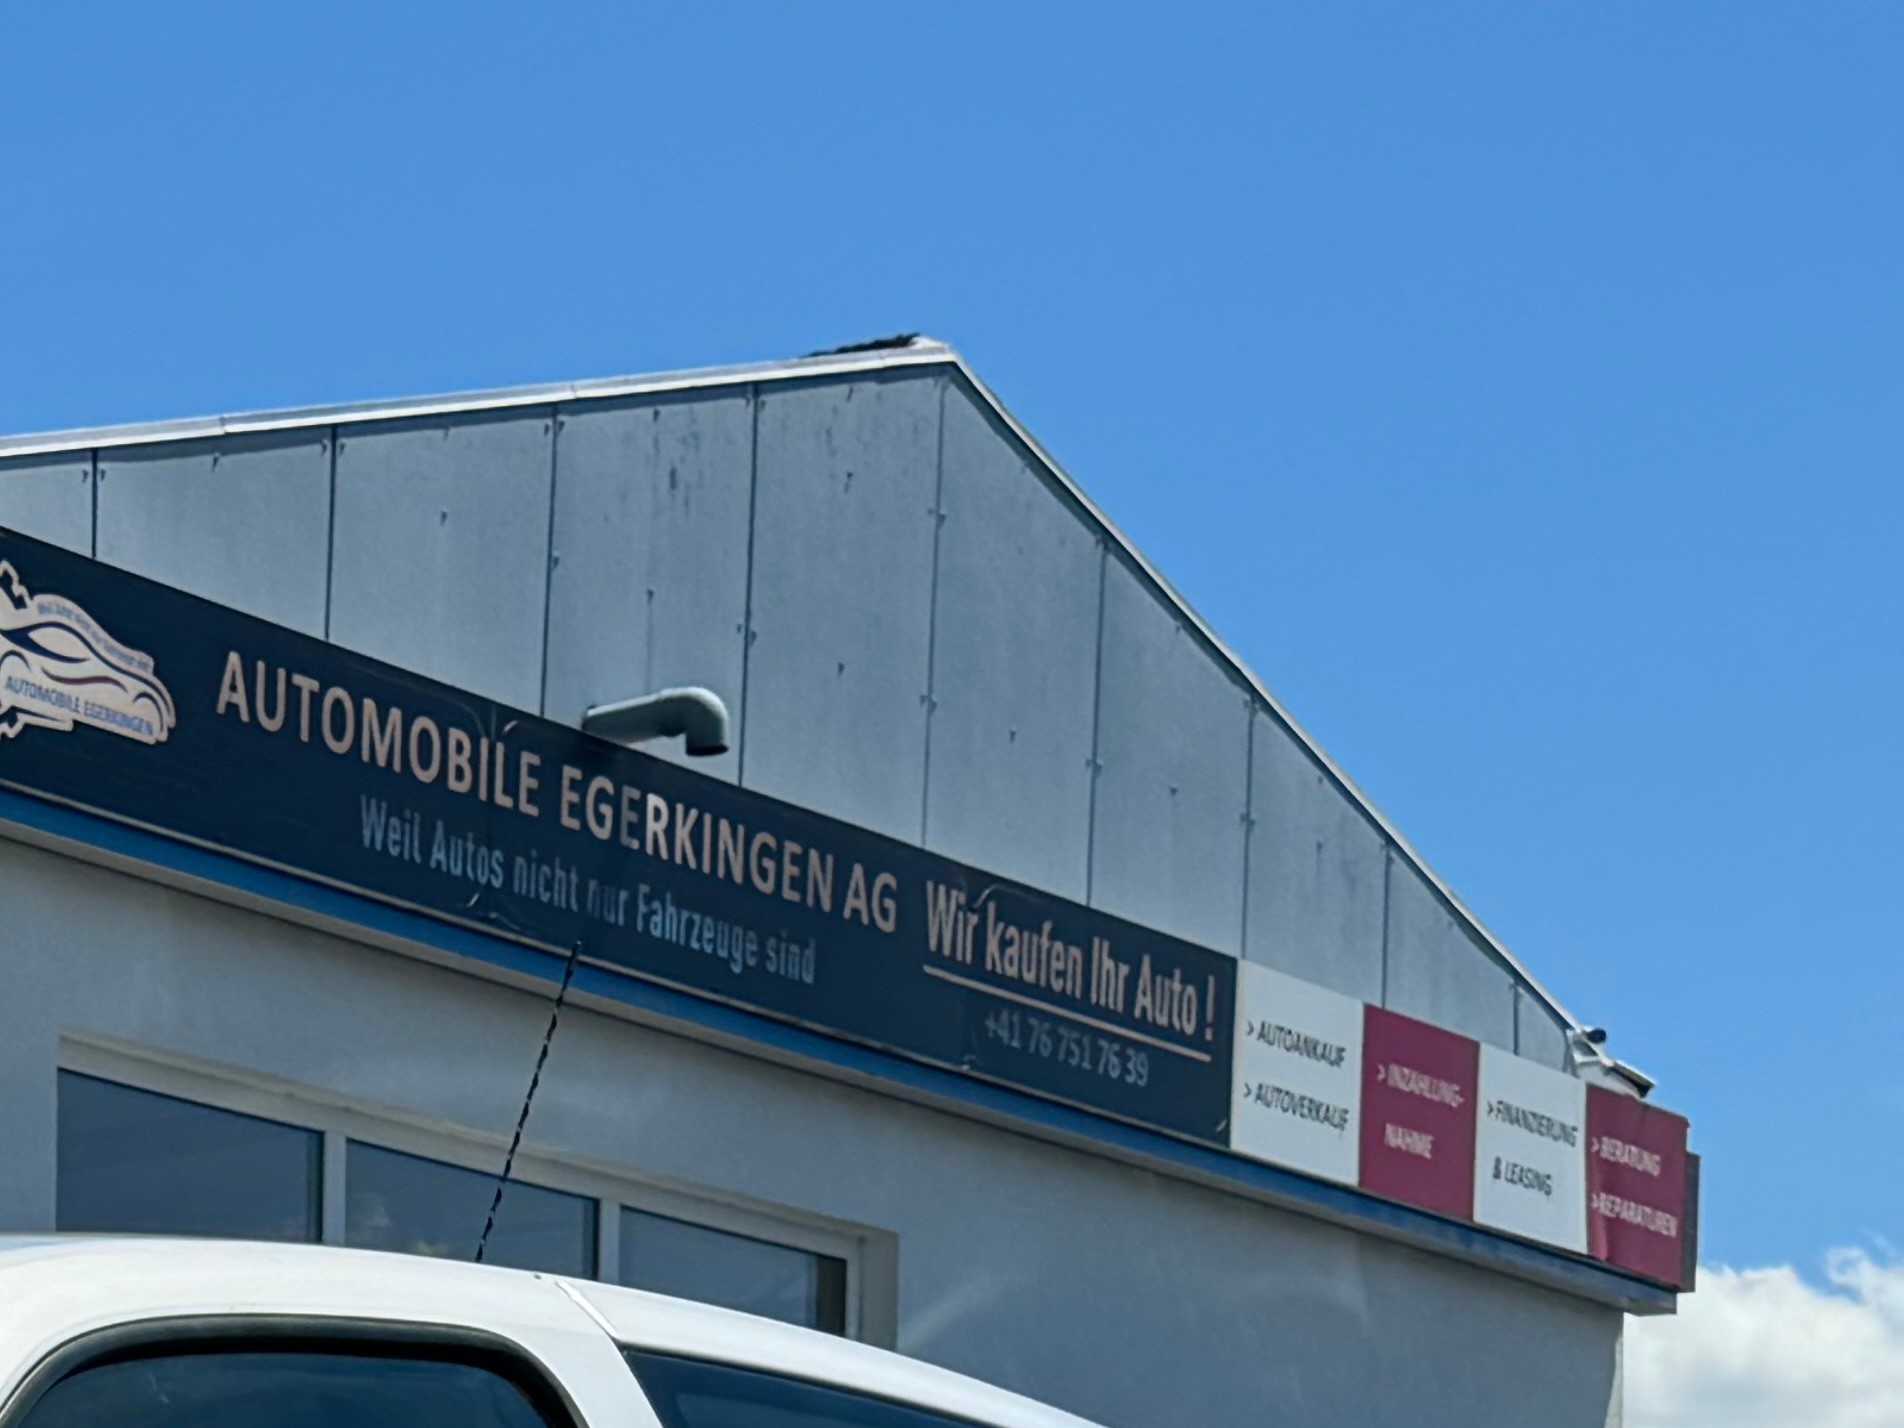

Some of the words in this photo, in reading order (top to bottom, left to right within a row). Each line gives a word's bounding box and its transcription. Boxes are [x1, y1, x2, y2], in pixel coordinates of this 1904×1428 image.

[216, 651, 540, 818] AUTOMOBILE
[559, 765, 835, 913] EGERKINGEN
[842, 862, 898, 934] AG
[360, 795, 422, 866] Weil
[429, 819, 505, 890] Autos
[513, 849, 580, 913] nicht
[587, 875, 630, 928] nur
[635, 882, 759, 970] Fahrzeuge
[764, 933, 817, 985] sind
[925, 880, 979, 966] Wir
[985, 902, 1084, 999] kaufen
[1091, 936, 1130, 1014] Ihr
[1134, 953, 1197, 1037] Auto
[985, 1008, 1021, 1049] +41
[1028, 1016, 1052, 1058] 76
[1057, 1025, 1092, 1070] 751
[1097, 1038, 1121, 1079] 76
[1124, 1045, 1149, 1088] 39
[1256, 1020, 1346, 1068] AUTOANKAUF
[1253, 1082, 1349, 1132] AUTOVERKAUF
[1504, 1160, 1553, 1198] LEASING
